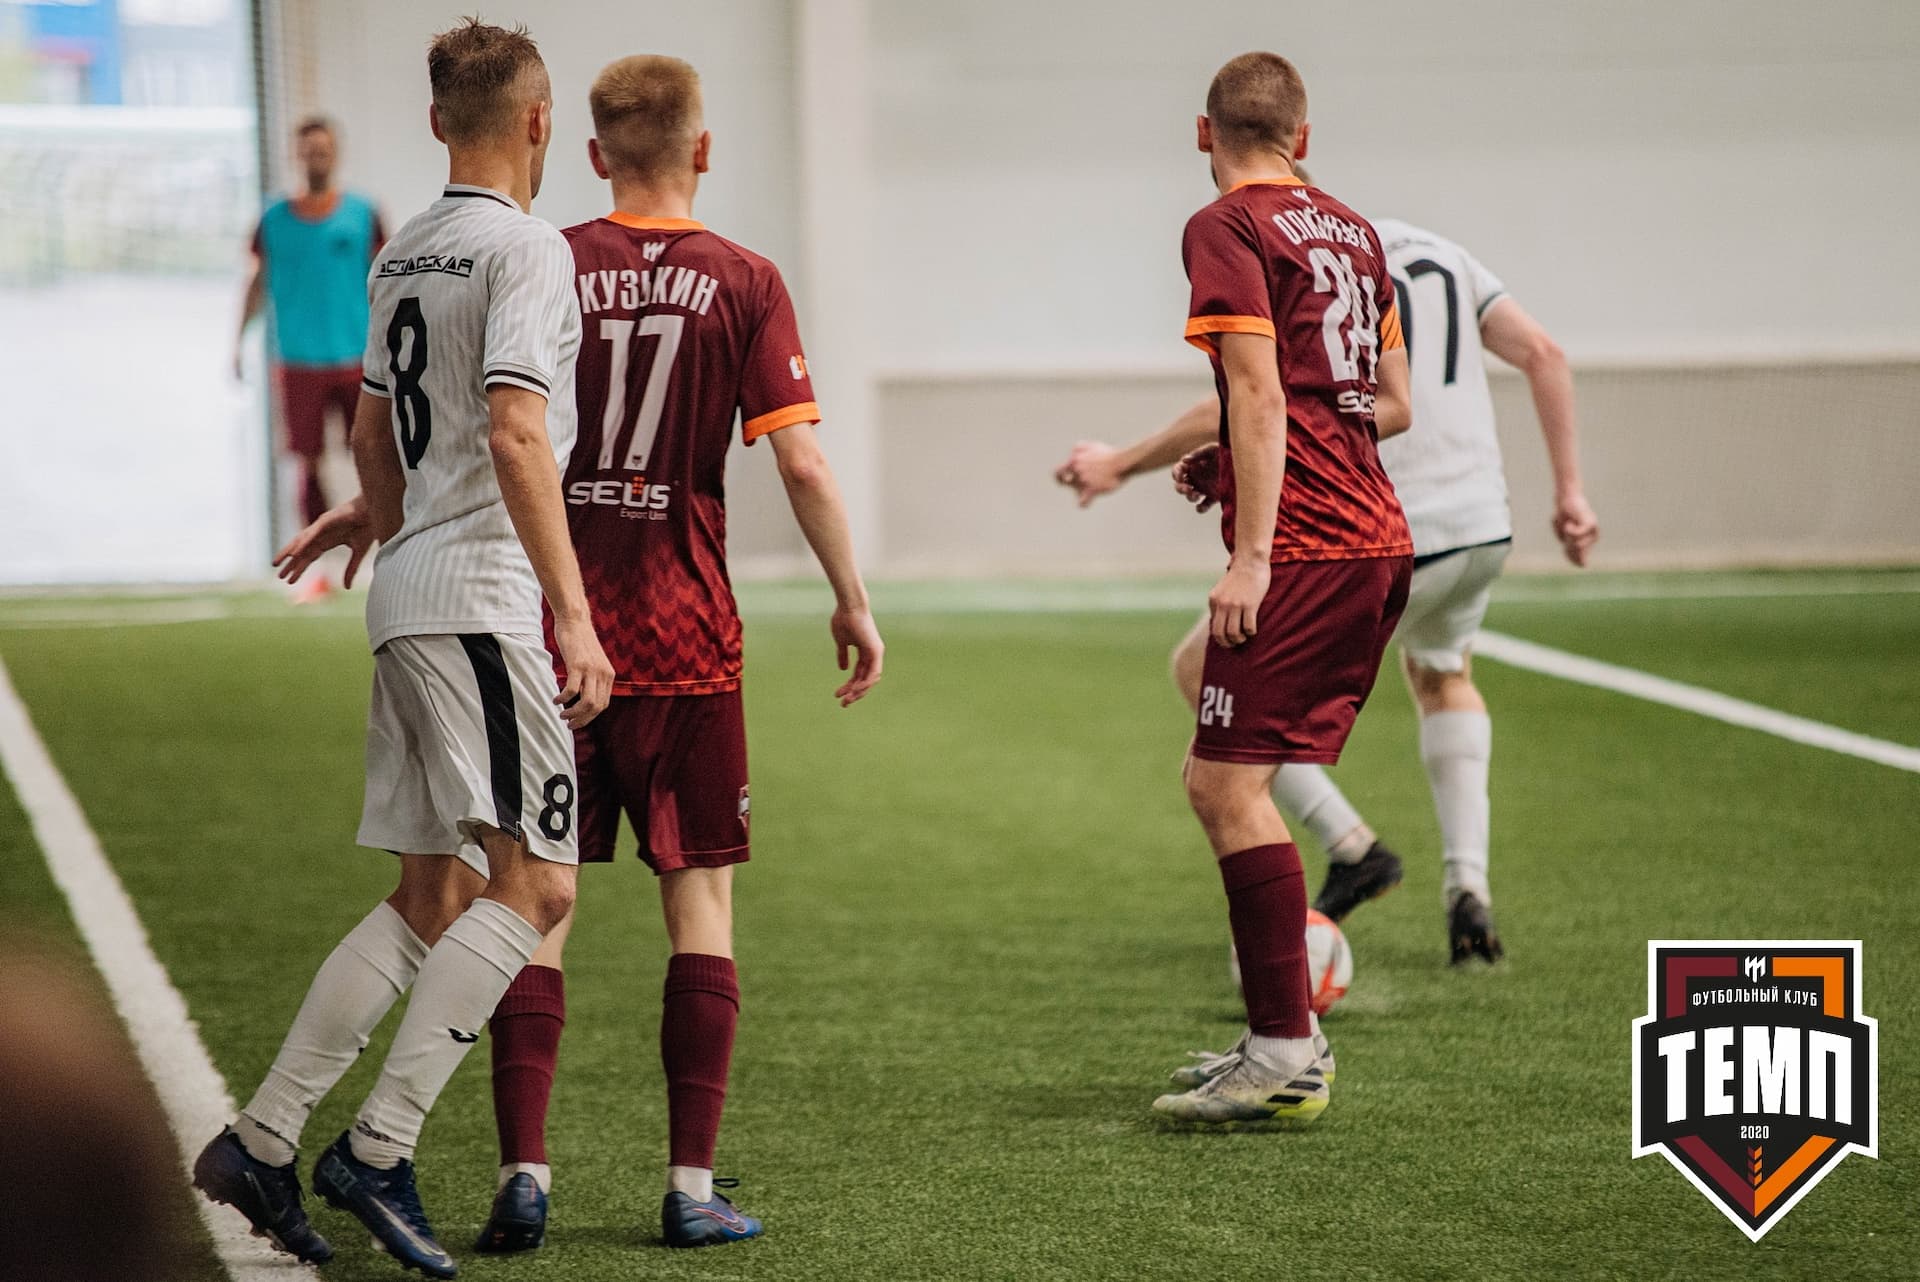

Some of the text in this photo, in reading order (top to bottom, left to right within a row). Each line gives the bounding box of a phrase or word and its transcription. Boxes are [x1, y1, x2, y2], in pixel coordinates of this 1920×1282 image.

[578, 266, 719, 316] КУЗЬКИН
[1308, 248, 1380, 384] 24
[387, 297, 431, 470] 8
[597, 314, 685, 471] 17
[1200, 686, 1234, 728] 24
[538, 773, 574, 842] 8
